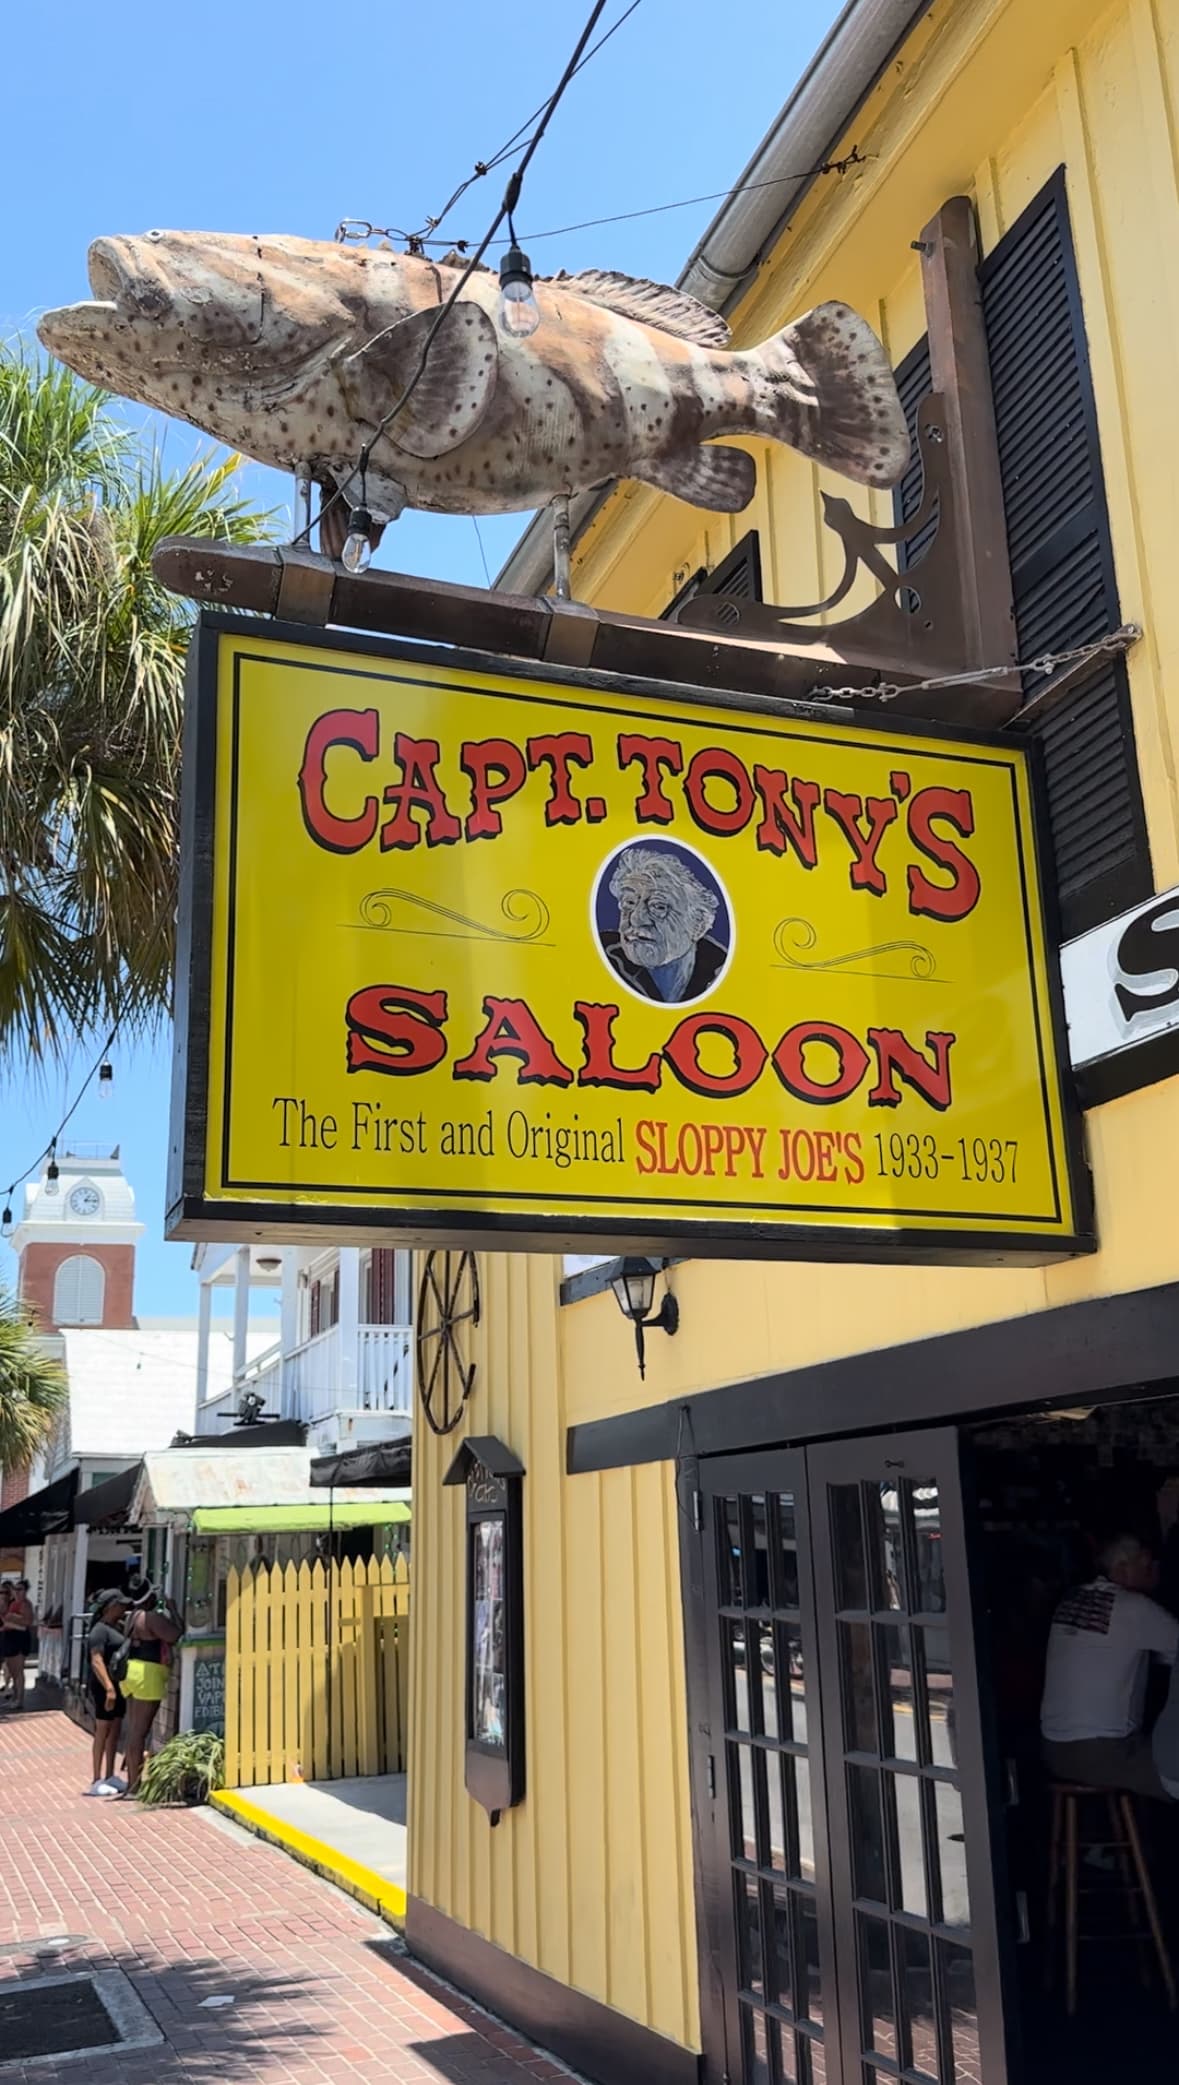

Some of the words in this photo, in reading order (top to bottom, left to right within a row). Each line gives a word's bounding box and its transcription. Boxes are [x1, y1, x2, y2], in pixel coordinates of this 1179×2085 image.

[297, 708, 607, 855] CAPT.
[617, 733, 981, 923] TONY'S
[346, 984, 956, 1112] SALOON
[272, 1097, 337, 1150] The
[351, 1102, 428, 1154] First
[440, 1110, 495, 1157] and
[507, 1110, 625, 1168] Original
[635, 1119, 767, 1179] SLOPPY
[777, 1128, 865, 1186] JOE'S
[873, 1132, 1019, 1184] 1933-1937
[198, 1690, 225, 1705] VAP
